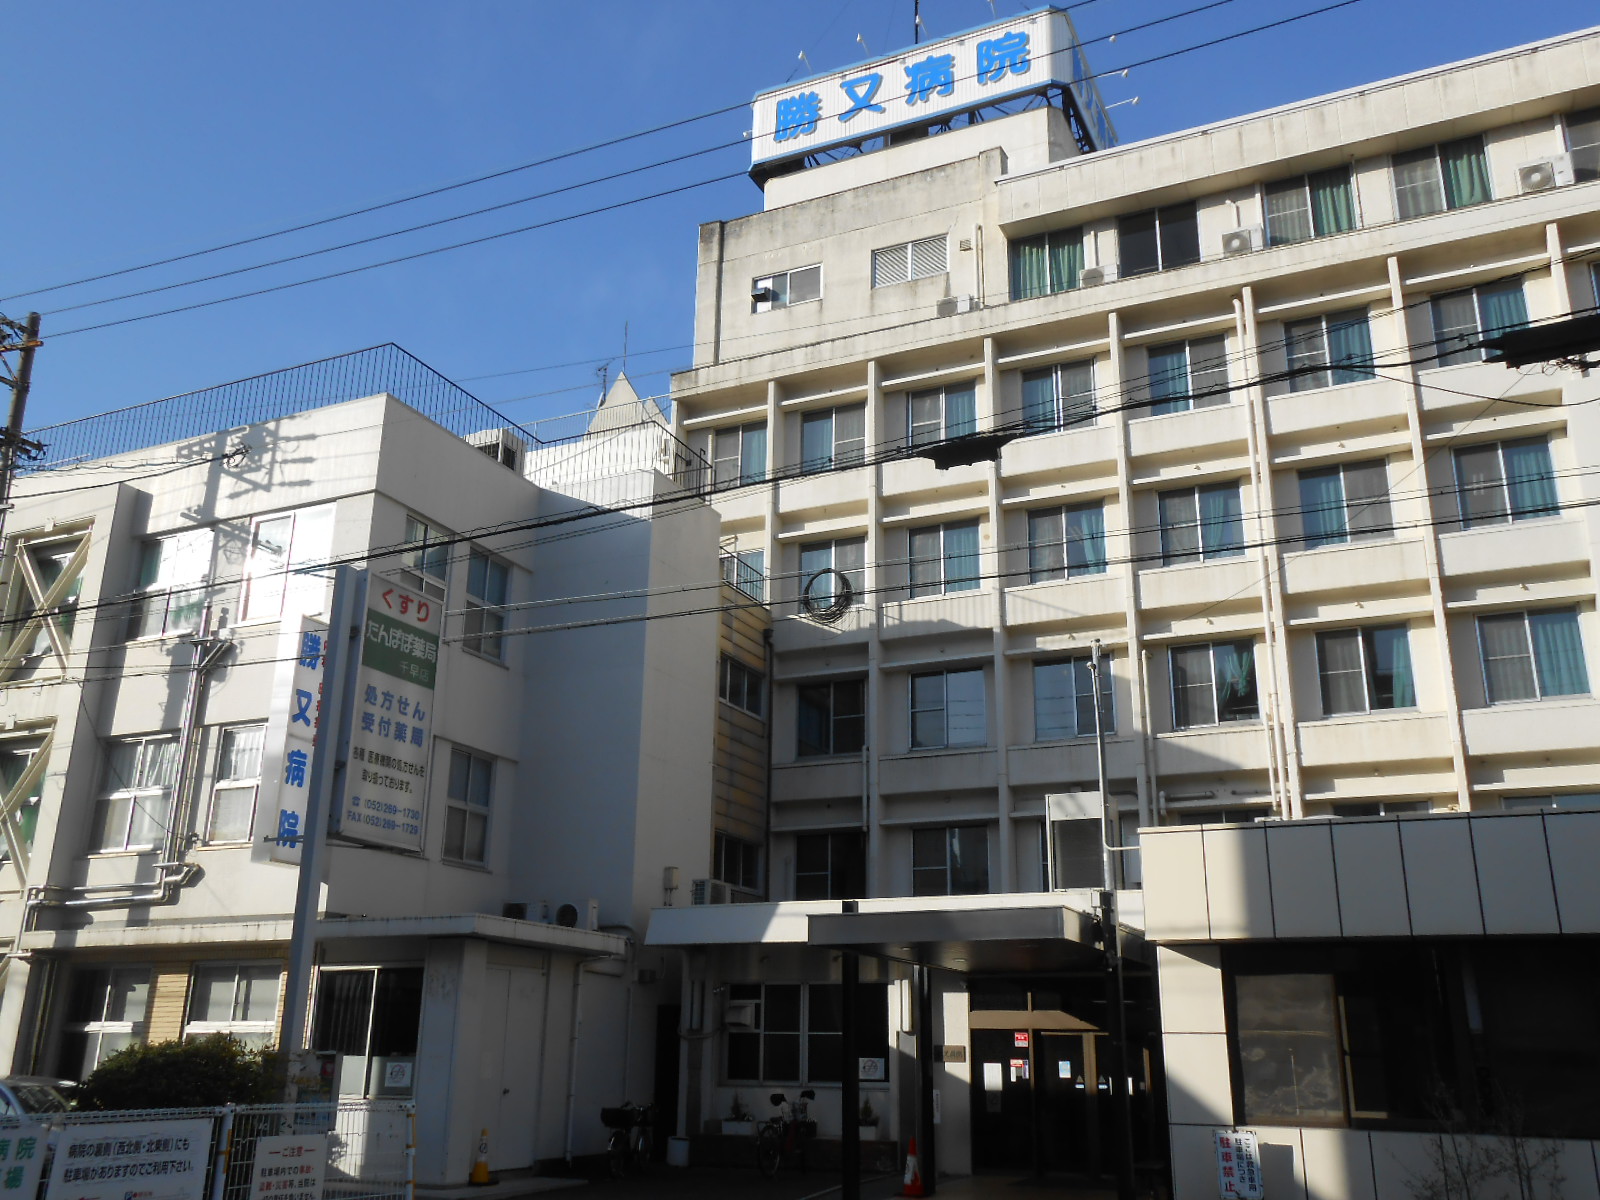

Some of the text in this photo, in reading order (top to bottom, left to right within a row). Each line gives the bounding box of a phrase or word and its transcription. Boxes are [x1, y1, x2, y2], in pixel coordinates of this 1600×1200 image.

[773, 31, 1030, 142] 勝又病院
[381, 588, 431, 622] くすり
[366, 619, 438, 663] たんぽぽ薬局
[399, 660, 430, 681] 千早店
[364, 684, 426, 721] 処方せん
[276, 631, 321, 849] 勝又病院
[361, 711, 424, 748] 受付薬局
[1219, 1136, 1236, 1193] 駐車禁止
